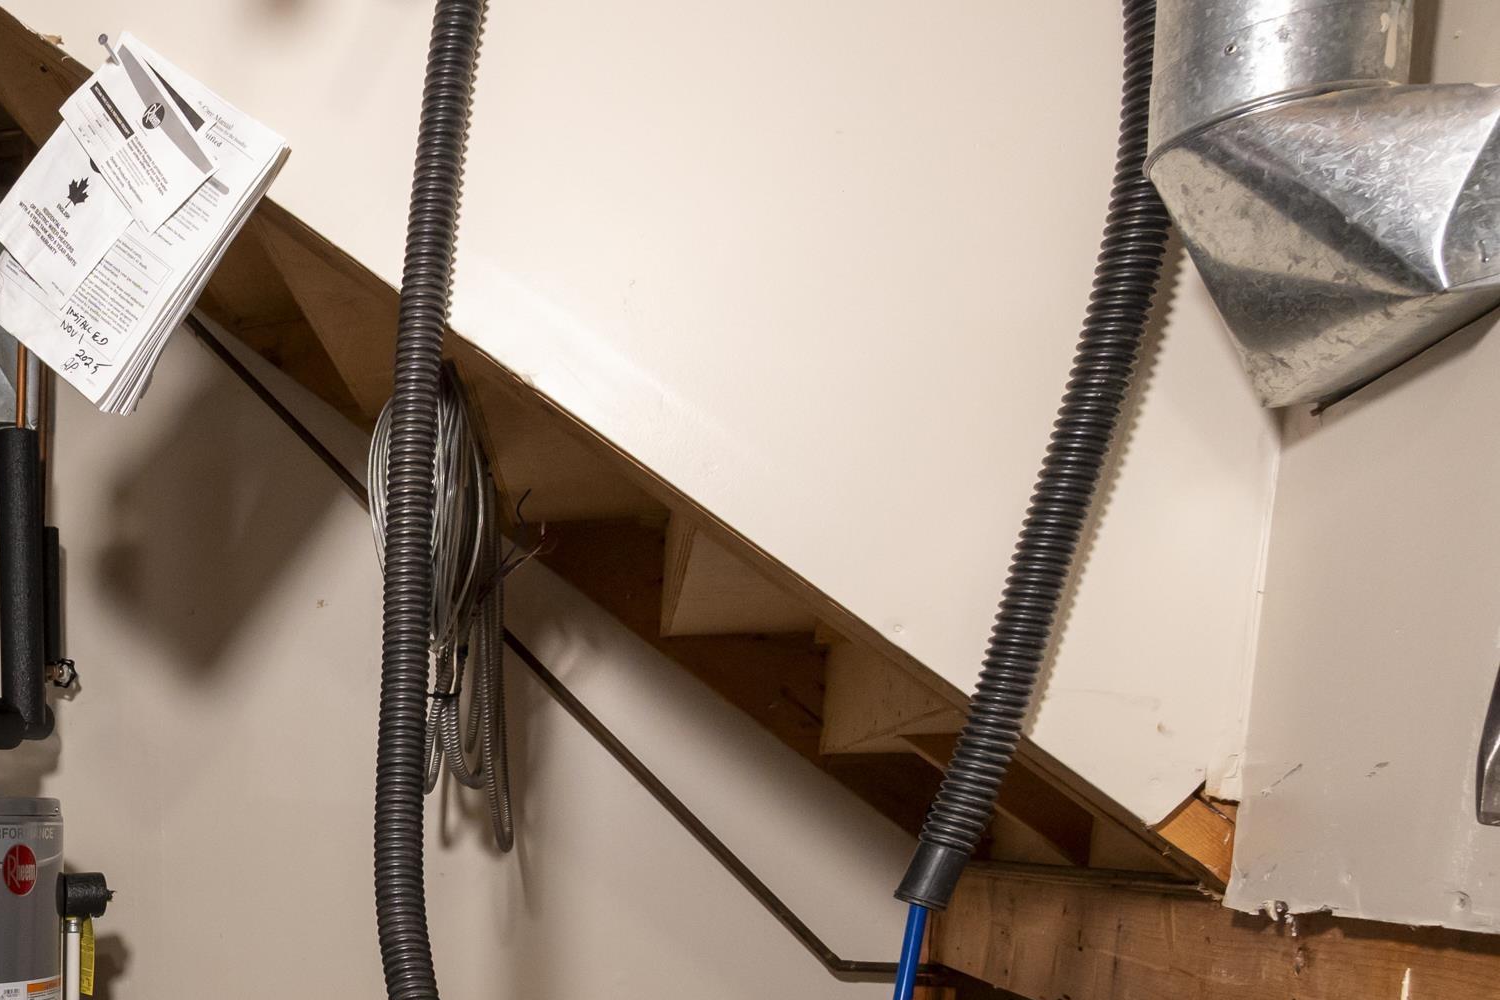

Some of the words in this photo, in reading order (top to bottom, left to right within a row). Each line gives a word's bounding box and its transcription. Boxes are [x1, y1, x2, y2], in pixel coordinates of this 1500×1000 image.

[58, 235, 74, 253] HEATERS
[60, 319, 77, 338] NOV
[66, 306, 109, 346] INSTALLED
[7, 846, 36, 889] Rheem
